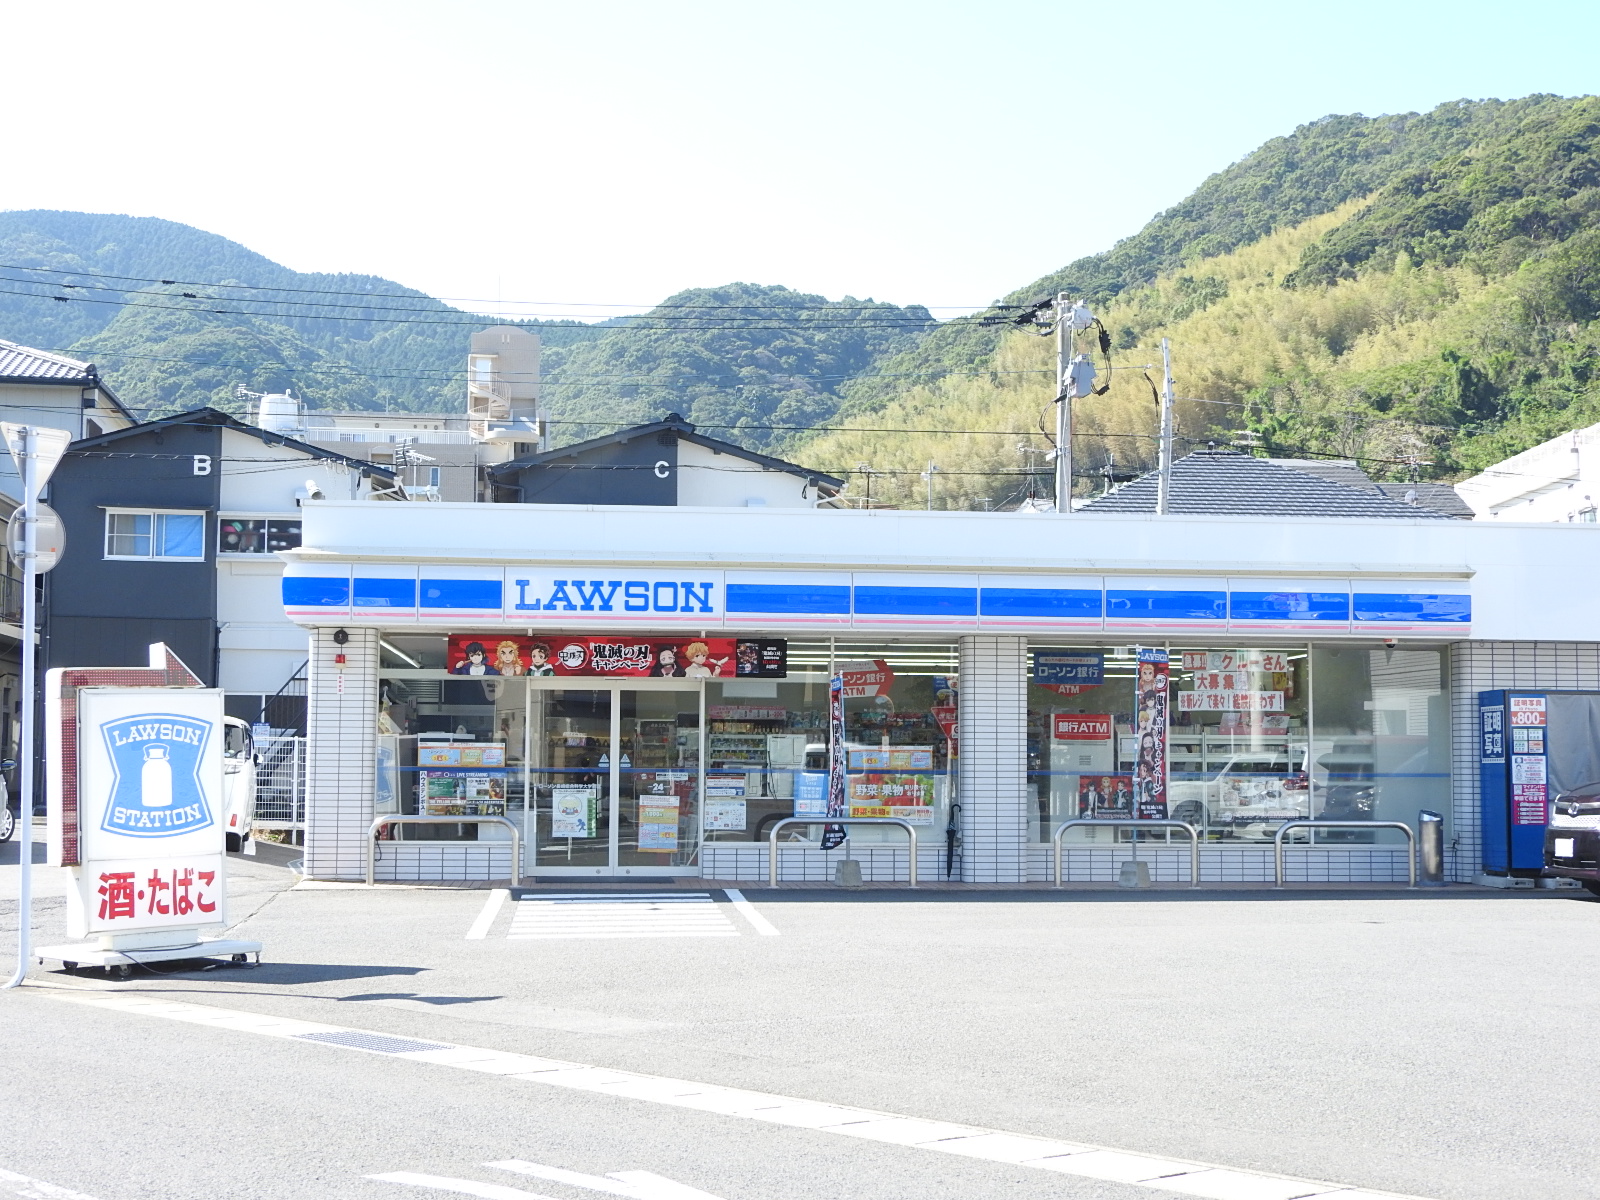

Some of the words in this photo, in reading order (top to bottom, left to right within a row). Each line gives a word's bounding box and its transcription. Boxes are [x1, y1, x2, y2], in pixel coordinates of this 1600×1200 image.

[193, 454, 212, 476] B
[654, 460, 670, 479] C
[515, 579, 714, 613] LAWSON
[592, 659, 650, 671] キャンペーン
[842, 672, 886, 684] ーソン銀行
[1038, 666, 1099, 678] ローソン銀行
[1196, 673, 1235, 690] 大募集
[842, 686, 866, 697] ATM
[1058, 685, 1080, 694] ATM
[1513, 699, 1542, 707] 証明写真
[1058, 721, 1107, 733] 銀行ATM
[113, 723, 202, 747] LAWSON
[1484, 733, 1502, 754] 写真
[652, 783, 664, 791] 24
[855, 783, 904, 796] 野菜・果物
[113, 803, 202, 828] STATION
[97, 867, 216, 920] 酒・たばこ
